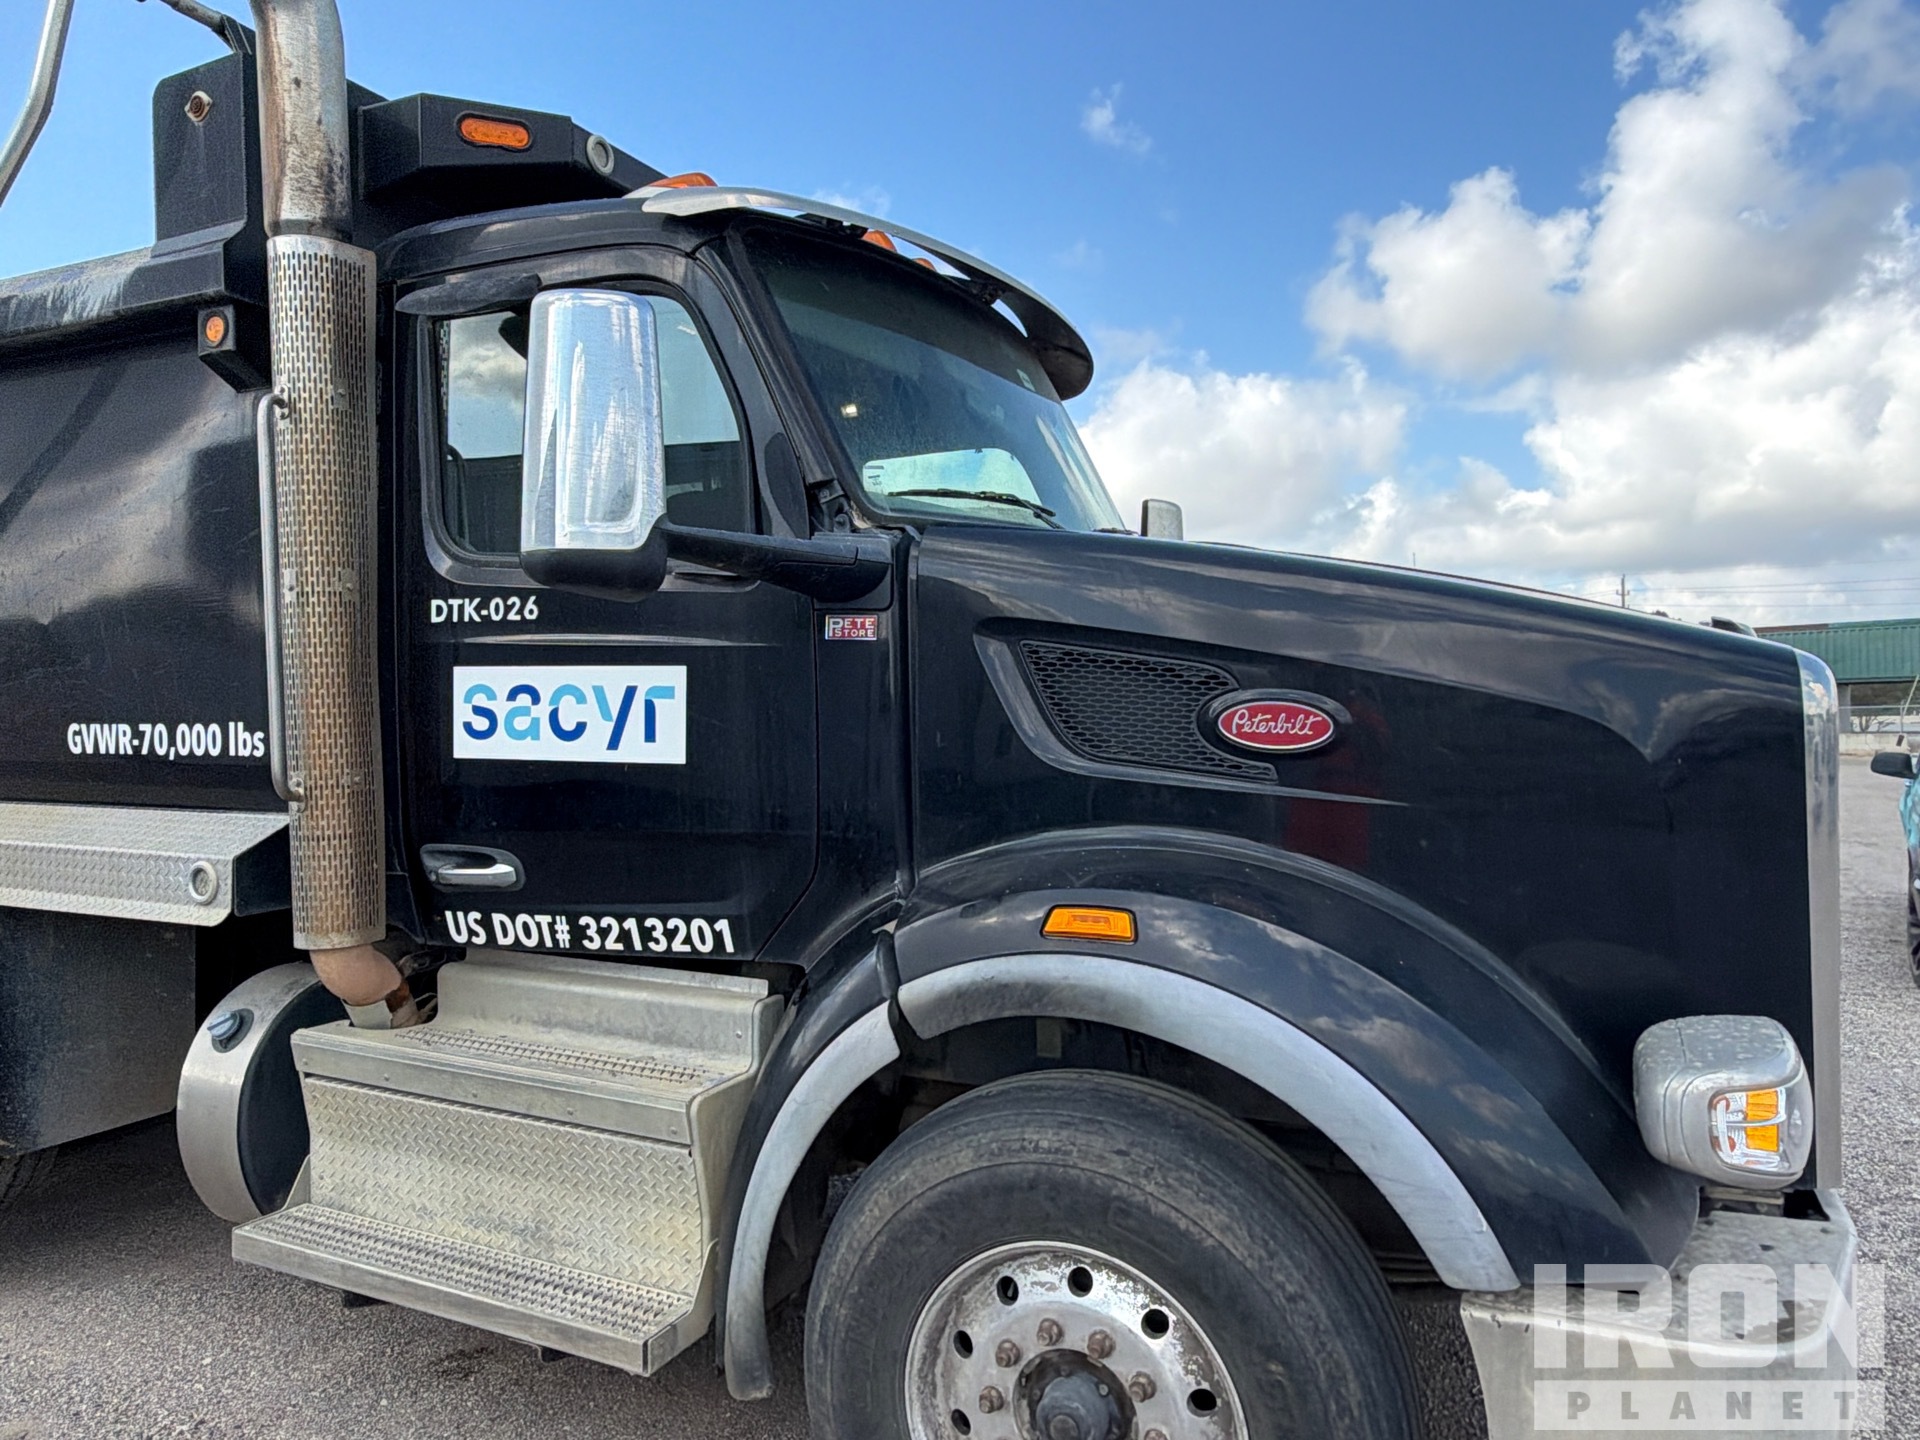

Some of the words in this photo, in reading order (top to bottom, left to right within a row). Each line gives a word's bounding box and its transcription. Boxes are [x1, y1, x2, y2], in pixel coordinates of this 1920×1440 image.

[430, 595, 539, 624] DTK-026
[829, 618, 875, 637] PETE
[835, 629, 875, 637] STORE
[462, 683, 676, 751] sacyr
[1232, 709, 1322, 735] Peterbilt
[67, 722, 222, 761] GVWR-70,000
[228, 721, 265, 758] lbs
[444, 910, 487, 946] US
[491, 913, 571, 949] DOT#
[578, 916, 735, 953] 3213201
